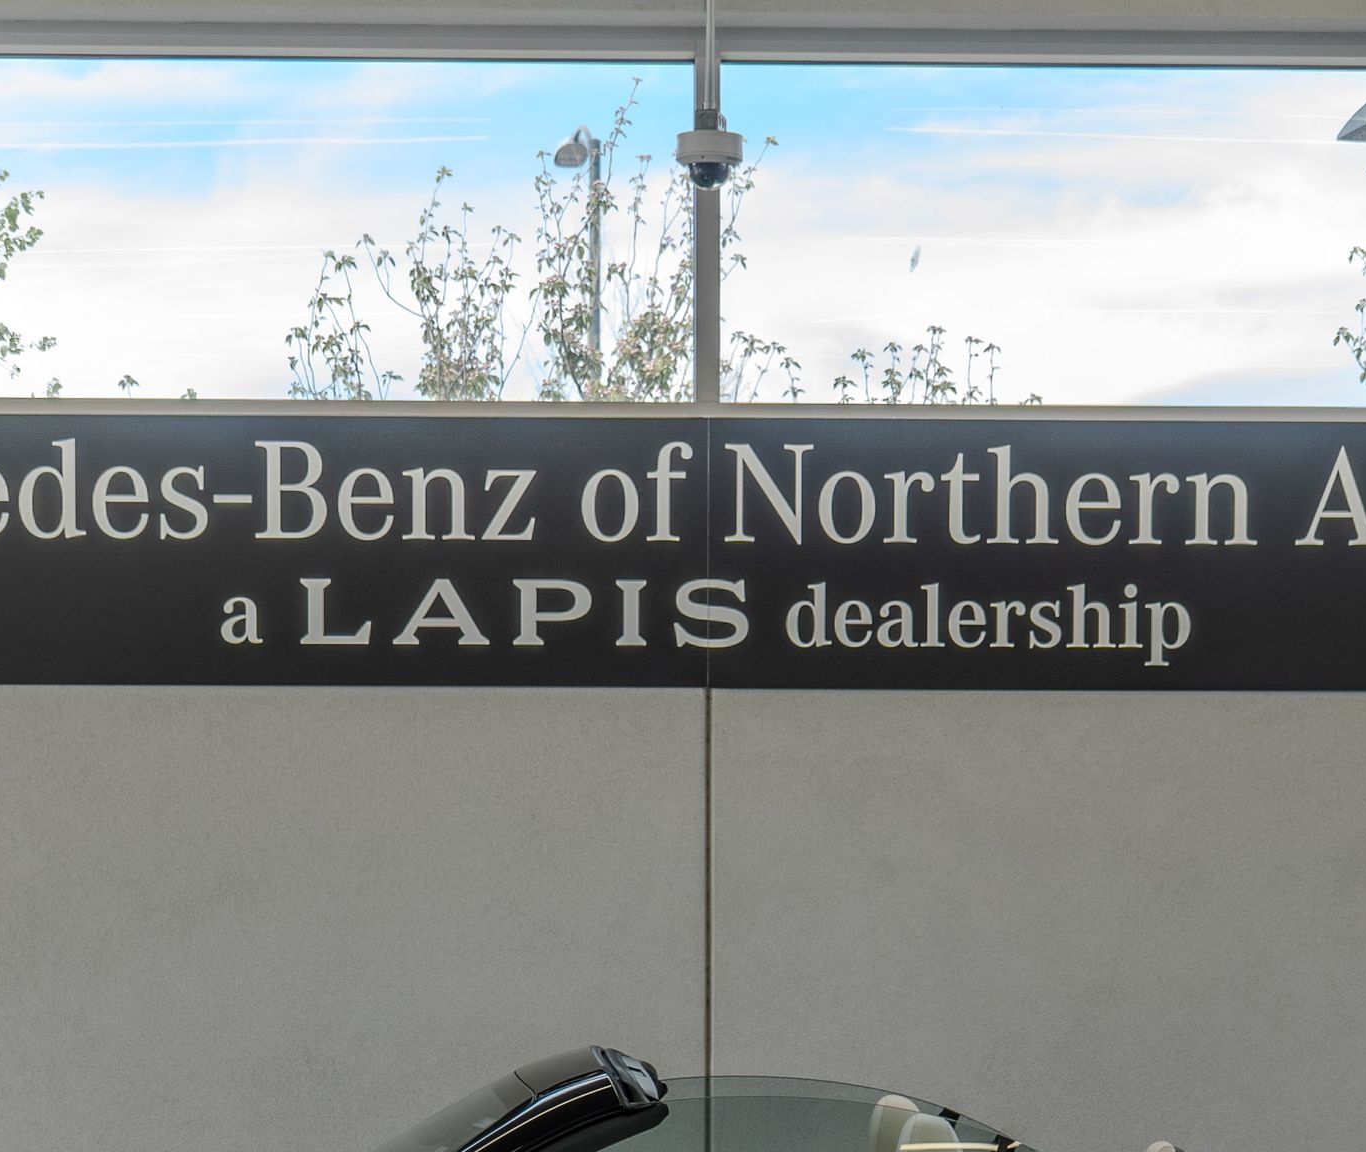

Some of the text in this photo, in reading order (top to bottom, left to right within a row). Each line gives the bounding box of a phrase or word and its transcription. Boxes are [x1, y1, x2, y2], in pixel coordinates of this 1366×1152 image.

[580, 440, 694, 543] of
[724, 442, 1258, 547] Northern
[220, 577, 1192, 667] a LAPIS dealership
